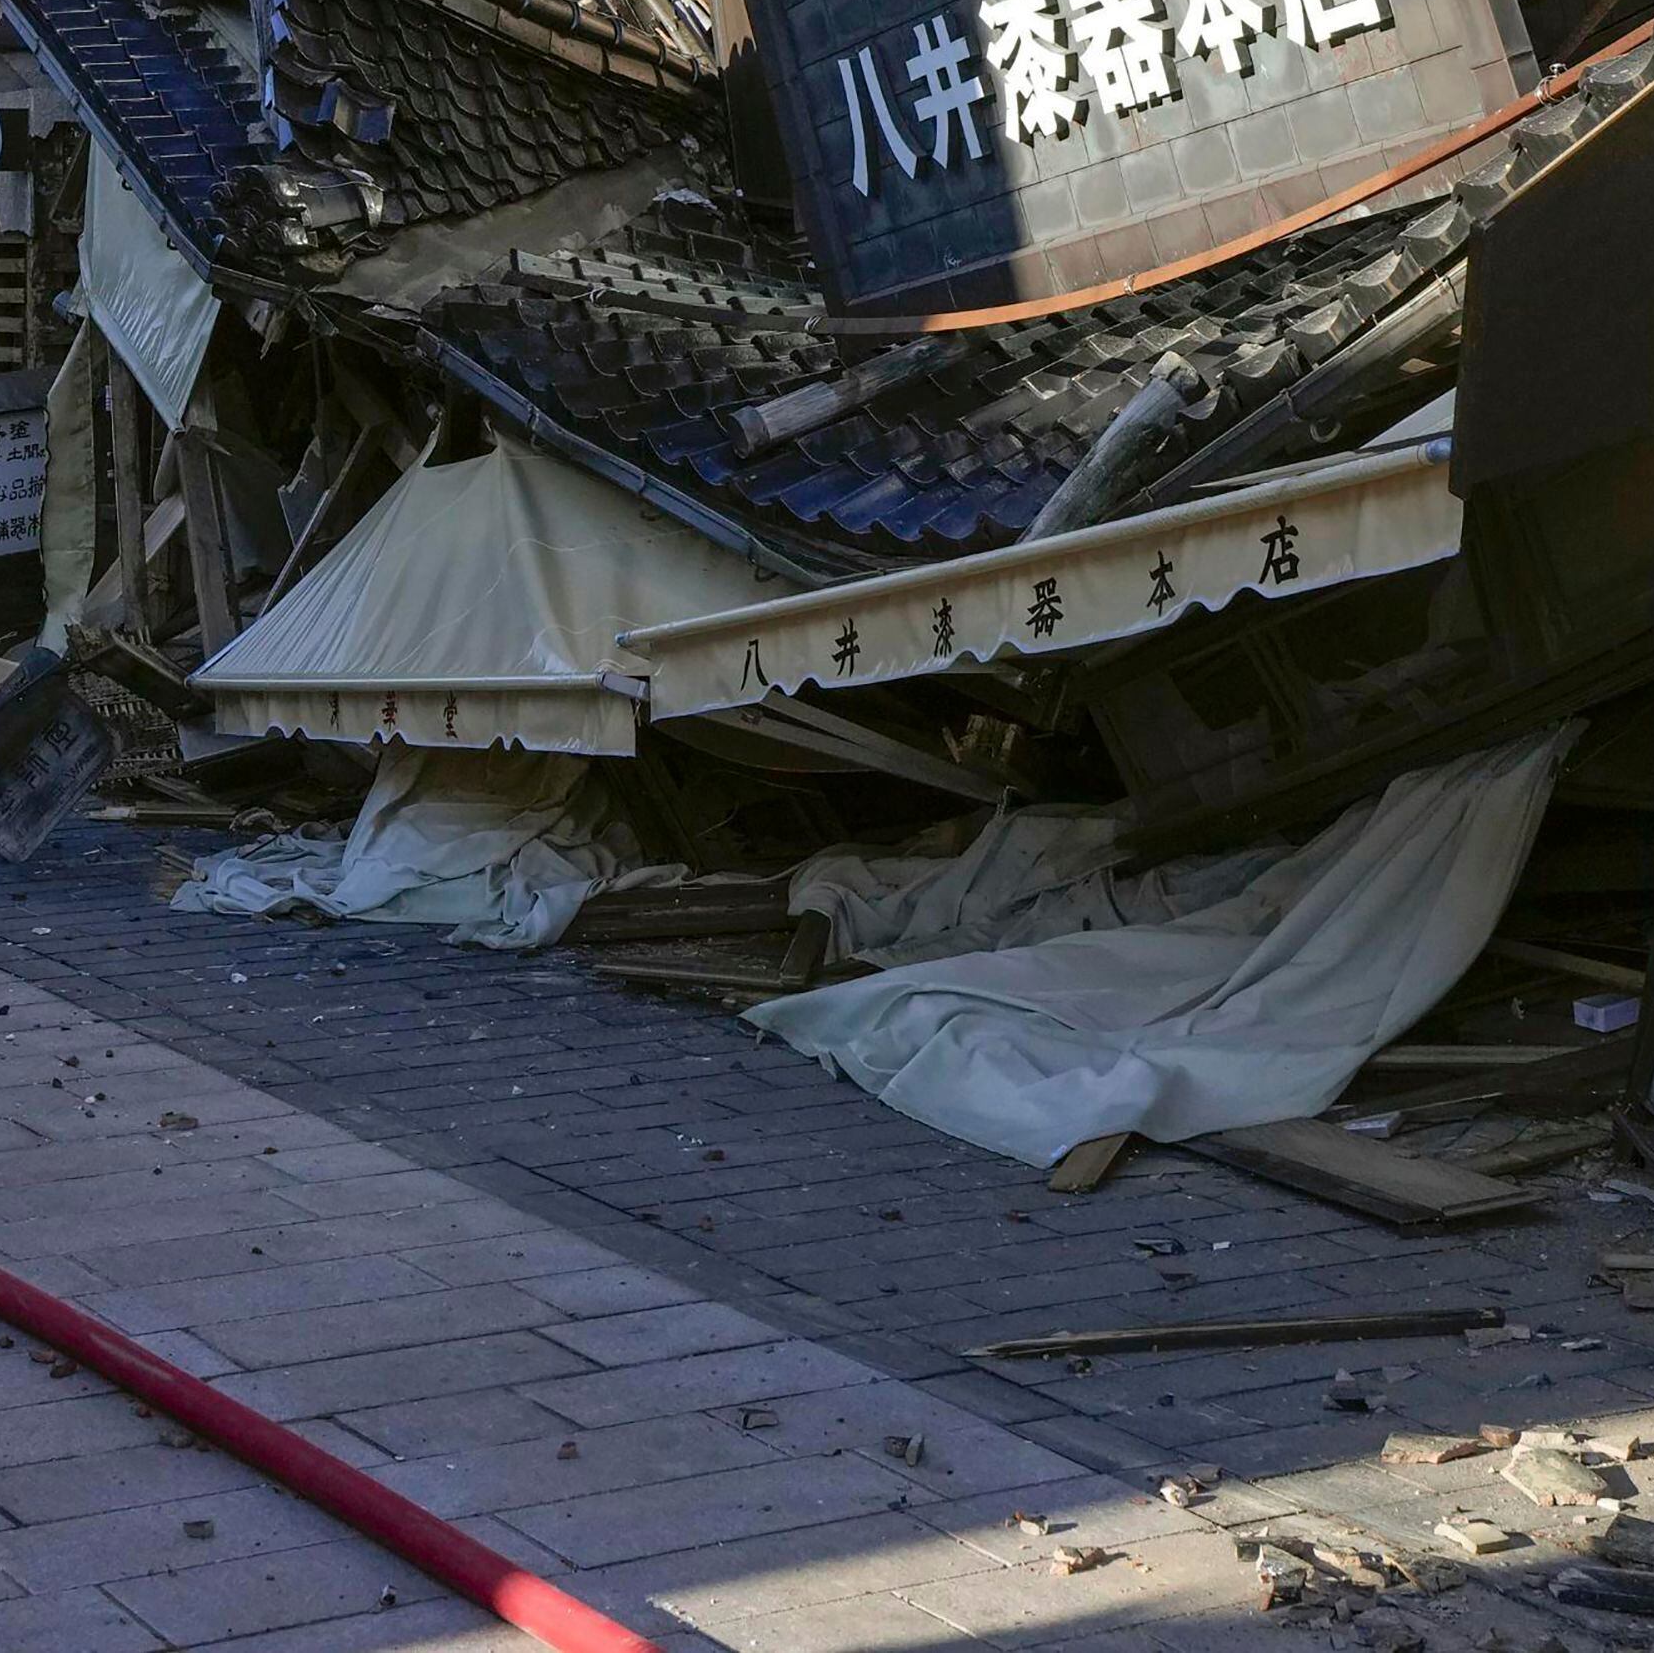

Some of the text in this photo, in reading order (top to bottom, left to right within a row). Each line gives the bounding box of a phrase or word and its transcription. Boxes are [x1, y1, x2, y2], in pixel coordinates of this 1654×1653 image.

[740, 515, 1300, 691] 八井漆器本店
